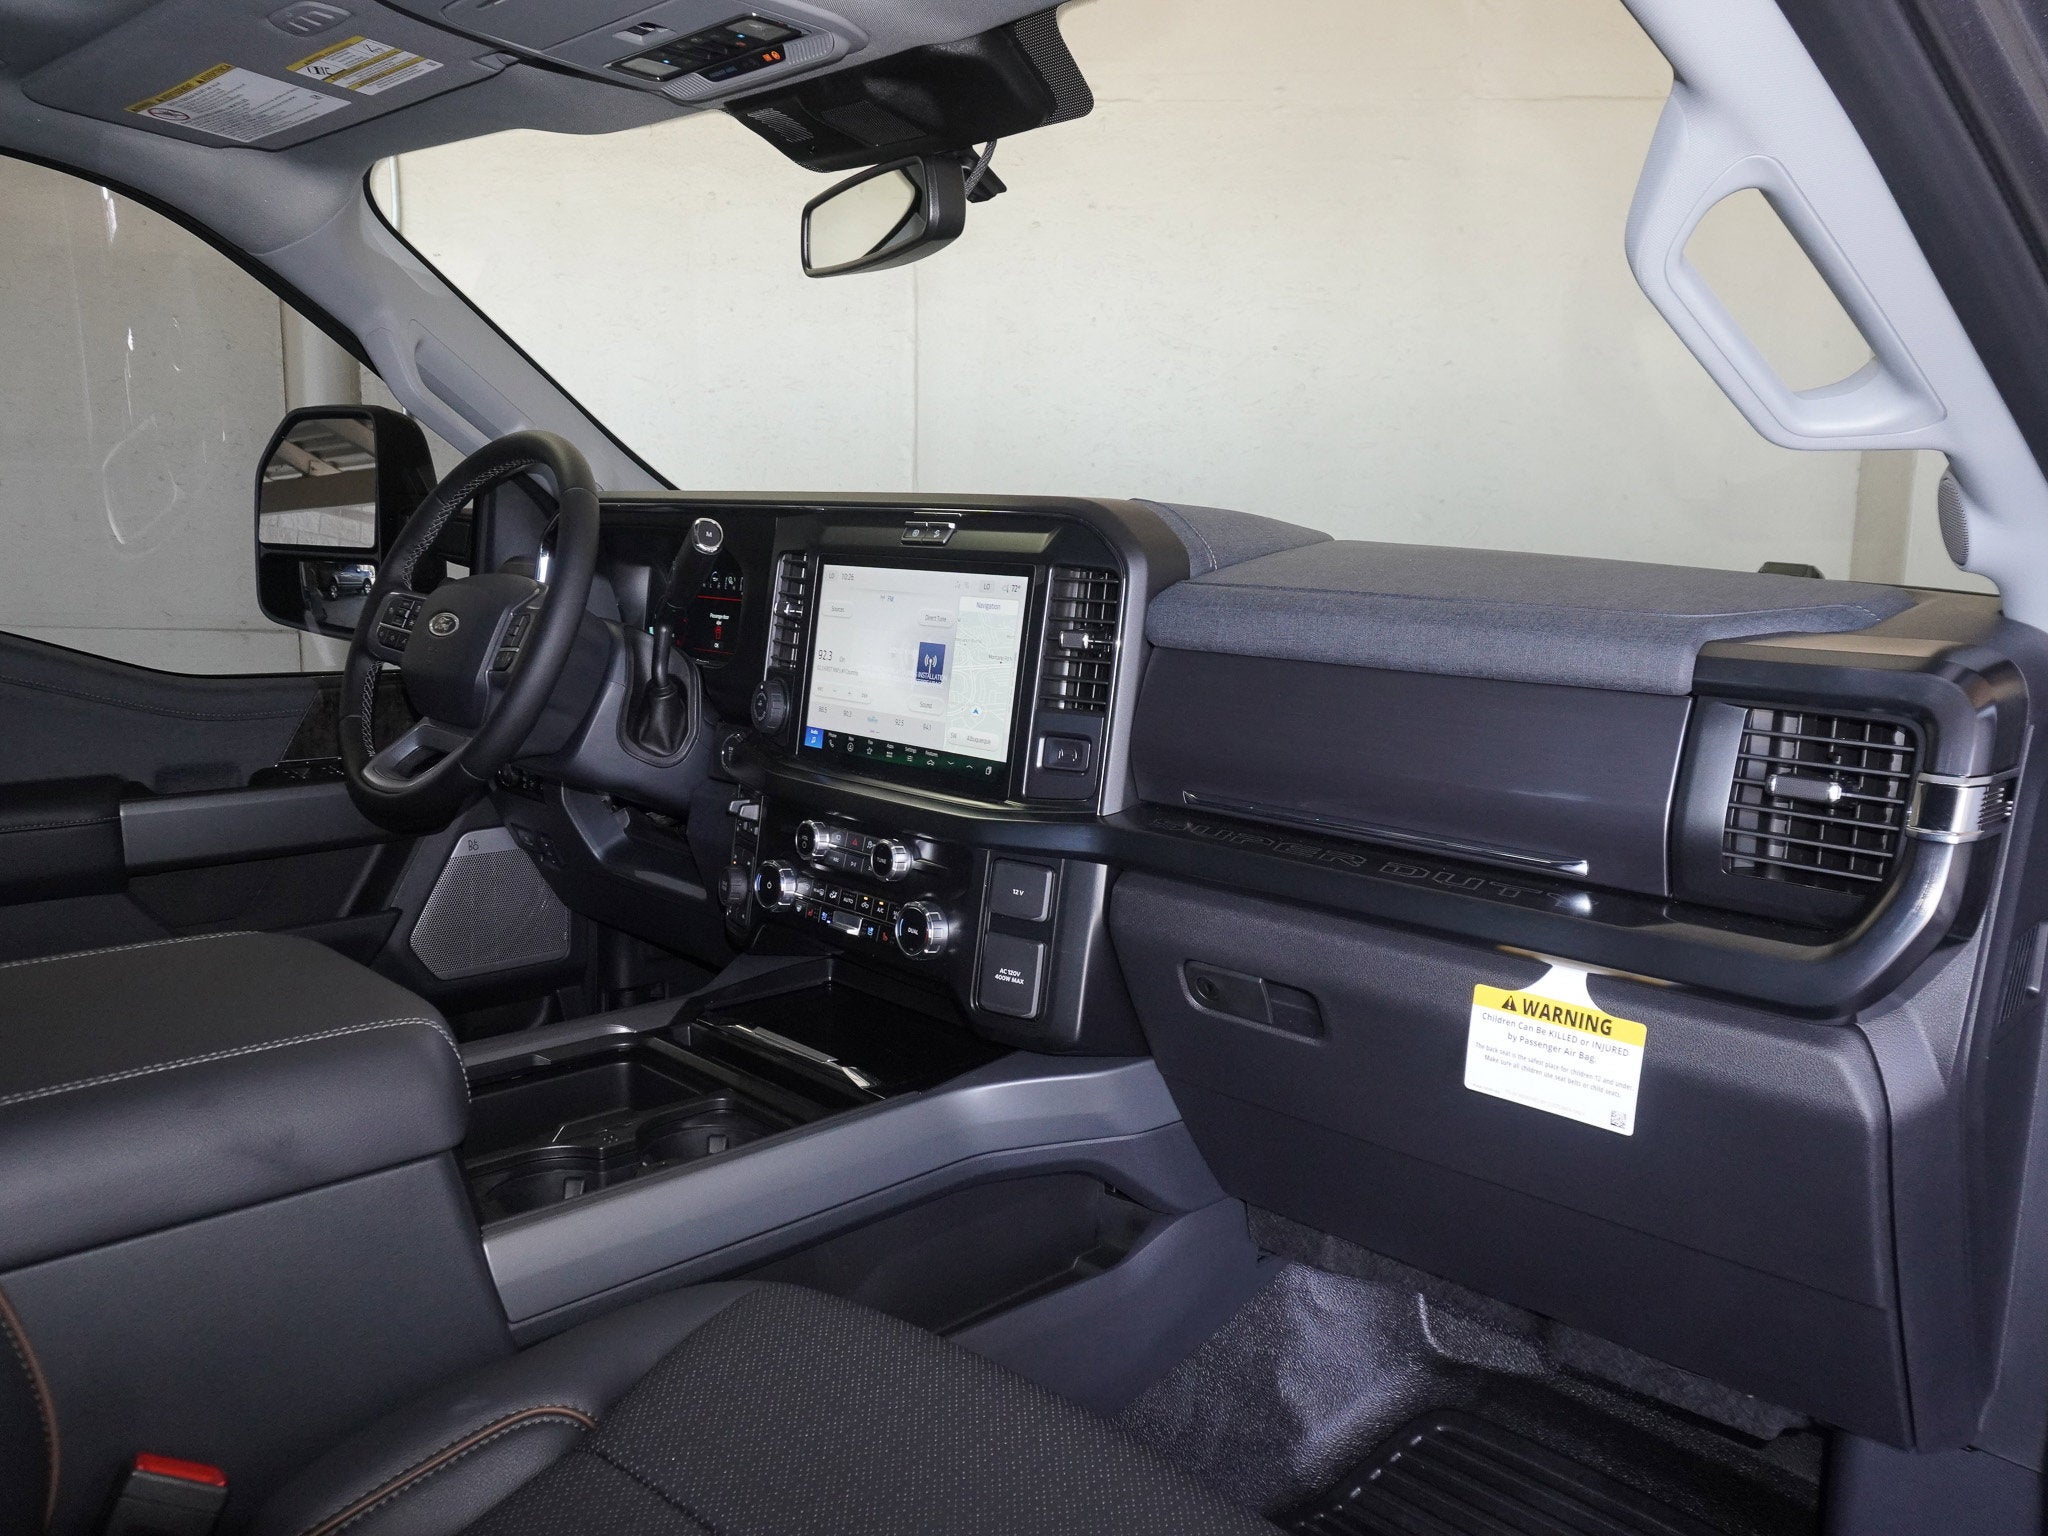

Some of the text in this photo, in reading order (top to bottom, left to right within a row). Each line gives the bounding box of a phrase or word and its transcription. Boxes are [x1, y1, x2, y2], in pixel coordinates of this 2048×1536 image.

[976, 602, 1001, 611] Navigation
[994, 973, 1025, 985] 400W MAX
[1007, 969, 1021, 977] 120V
[1522, 998, 1613, 1036] WARNING
[1482, 1012, 1629, 1057] Children Can Be KILLED or INJURED
[1507, 1032, 1518, 1043] by
[1519, 1035, 1562, 1055] Passenger
[1564, 1047, 1576, 1057] Air
[1475, 1041, 1485, 1050] The
[1486, 1044, 1498, 1053] back
[1499, 1049, 1511, 1057] seat
[1517, 1053, 1527, 1061] the
[1528, 1056, 1543, 1066] safest
[1544, 1061, 1560, 1071] place
[1570, 1067, 1594, 1081] children
[1603, 1077, 1614, 1086] and
[1484, 1054, 1499, 1064] Make
[1500, 1058, 1512, 1067] sure
[1521, 1063, 1543, 1077] children
[1544, 1071, 1553, 1079] use
[1555, 1073, 1567, 1083] seat
[1567, 1077, 1582, 1088] belts
[1590, 1083, 1604, 1093] child
